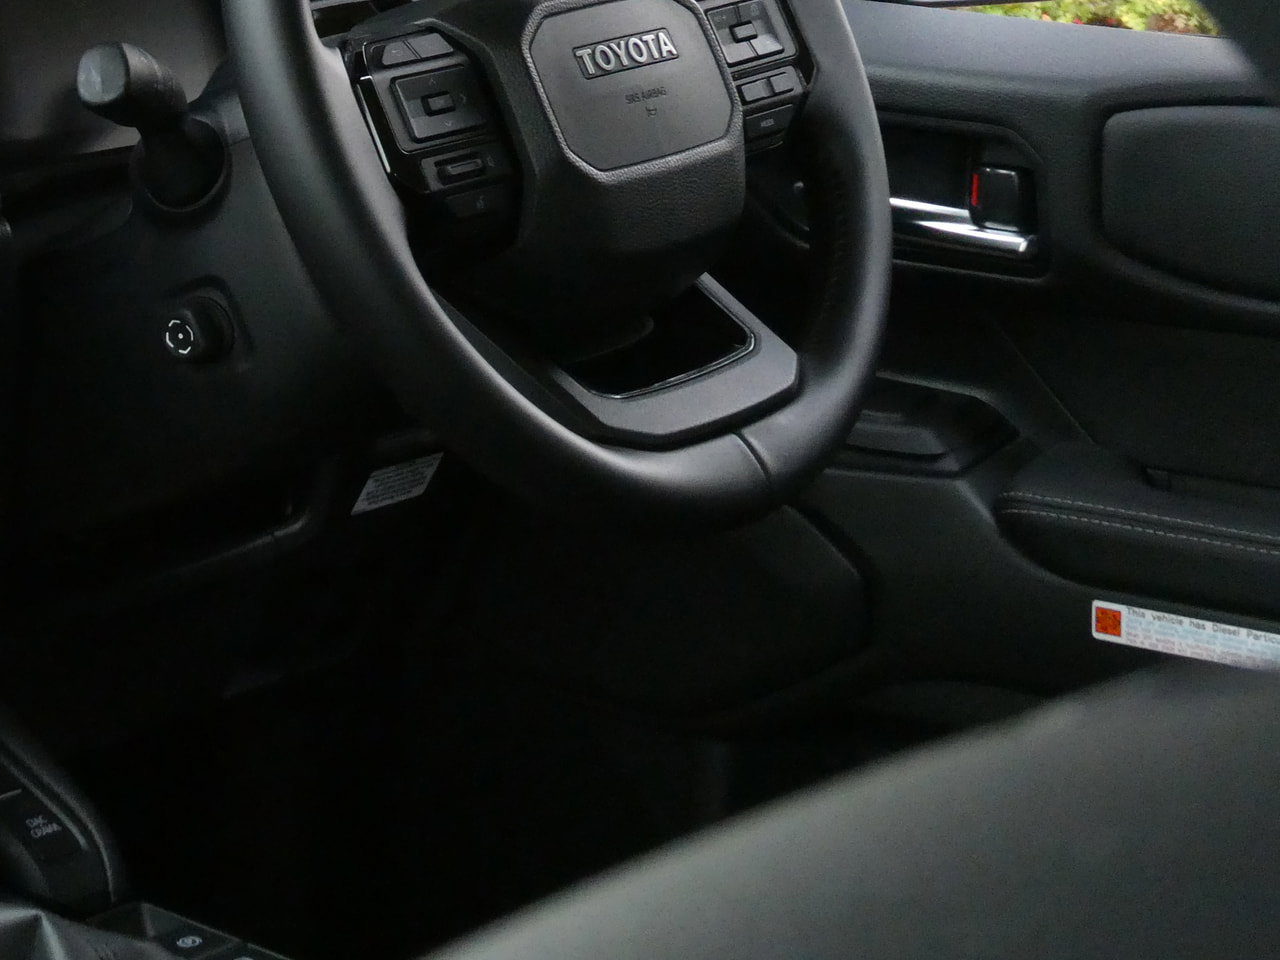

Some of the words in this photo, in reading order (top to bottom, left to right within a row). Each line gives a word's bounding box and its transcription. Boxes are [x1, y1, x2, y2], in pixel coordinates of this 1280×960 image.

[575, 31, 678, 75] TOYOTA
[1126, 605, 1147, 620] This
[1152, 614, 1185, 626] vehicle
[1189, 619, 1208, 631] has
[1212, 624, 1241, 637] Diesel
